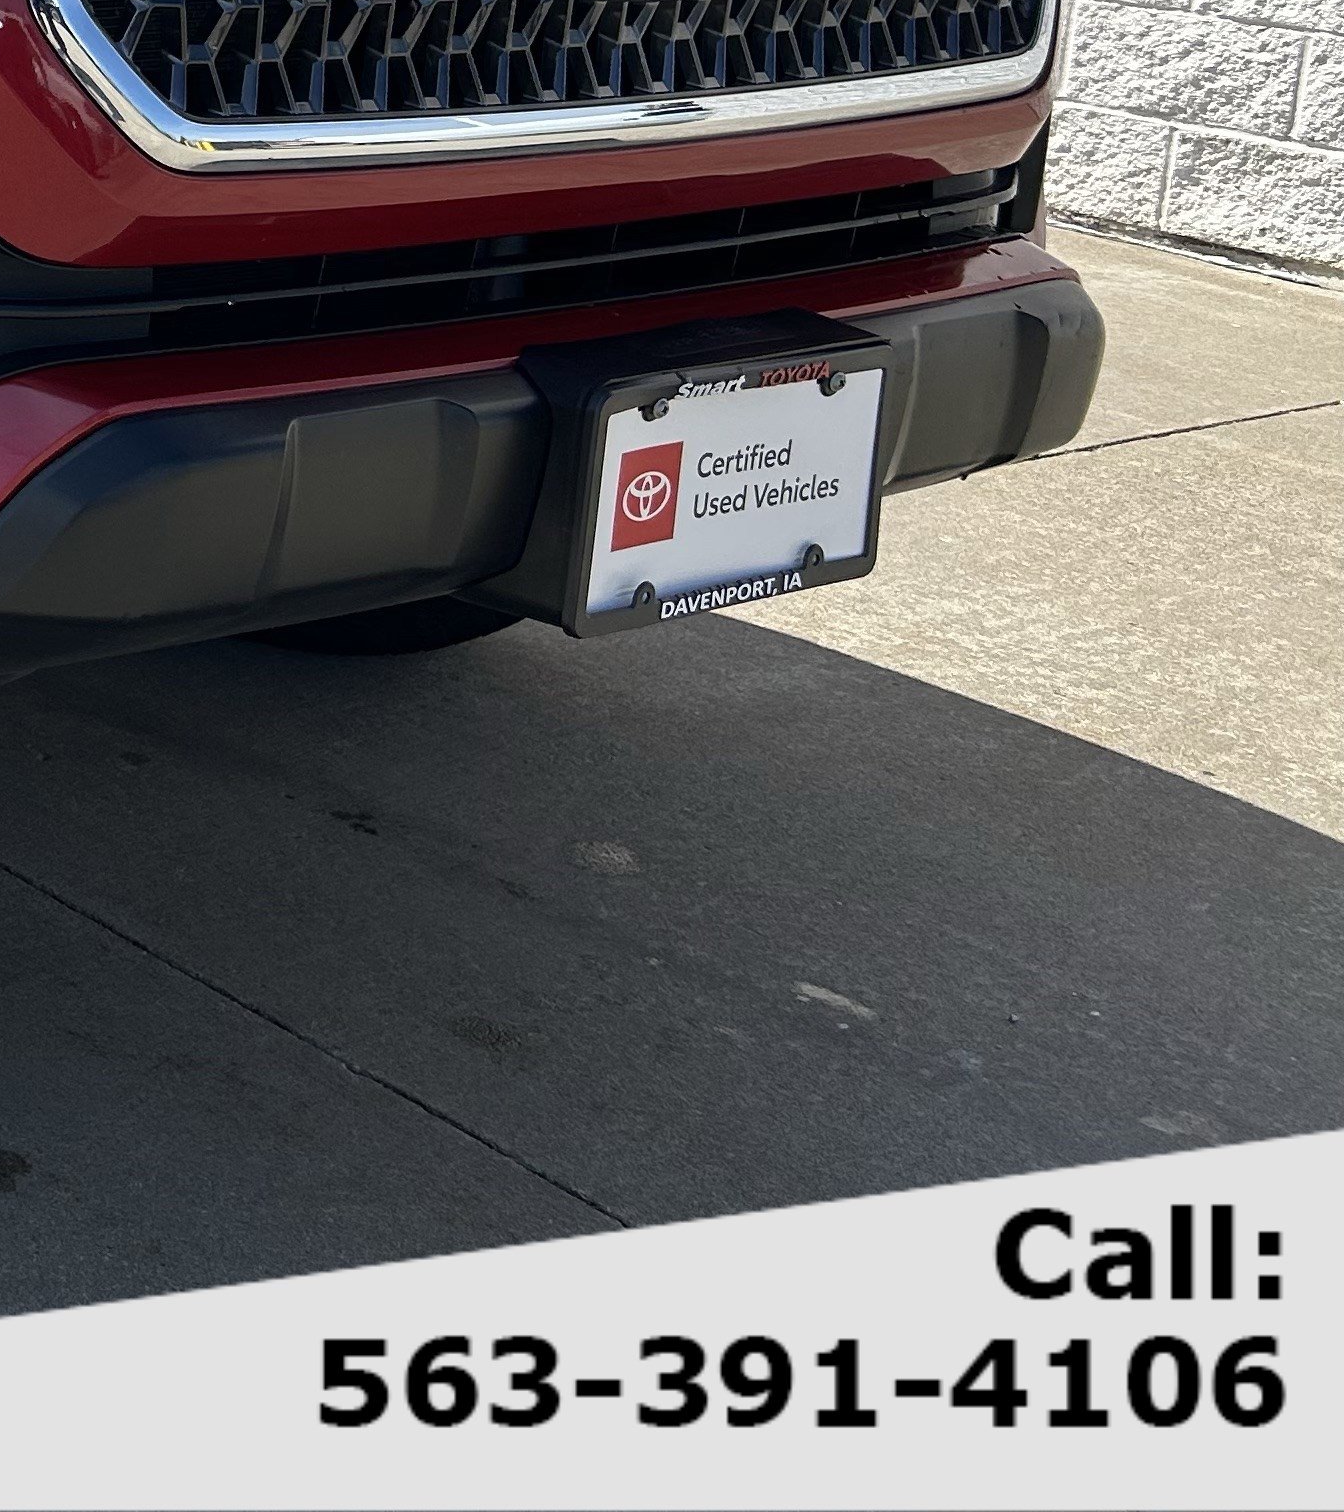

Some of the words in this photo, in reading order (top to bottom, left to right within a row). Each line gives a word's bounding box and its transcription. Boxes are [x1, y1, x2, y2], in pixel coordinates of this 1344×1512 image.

[676, 374, 746, 399] Smart
[760, 359, 831, 388] TOYOTA
[697, 439, 792, 478] Certified
[693, 485, 748, 519] Used
[754, 473, 840, 509] Vehicles
[660, 577, 780, 620] DAVENPORT,
[783, 571, 802, 590] IA
